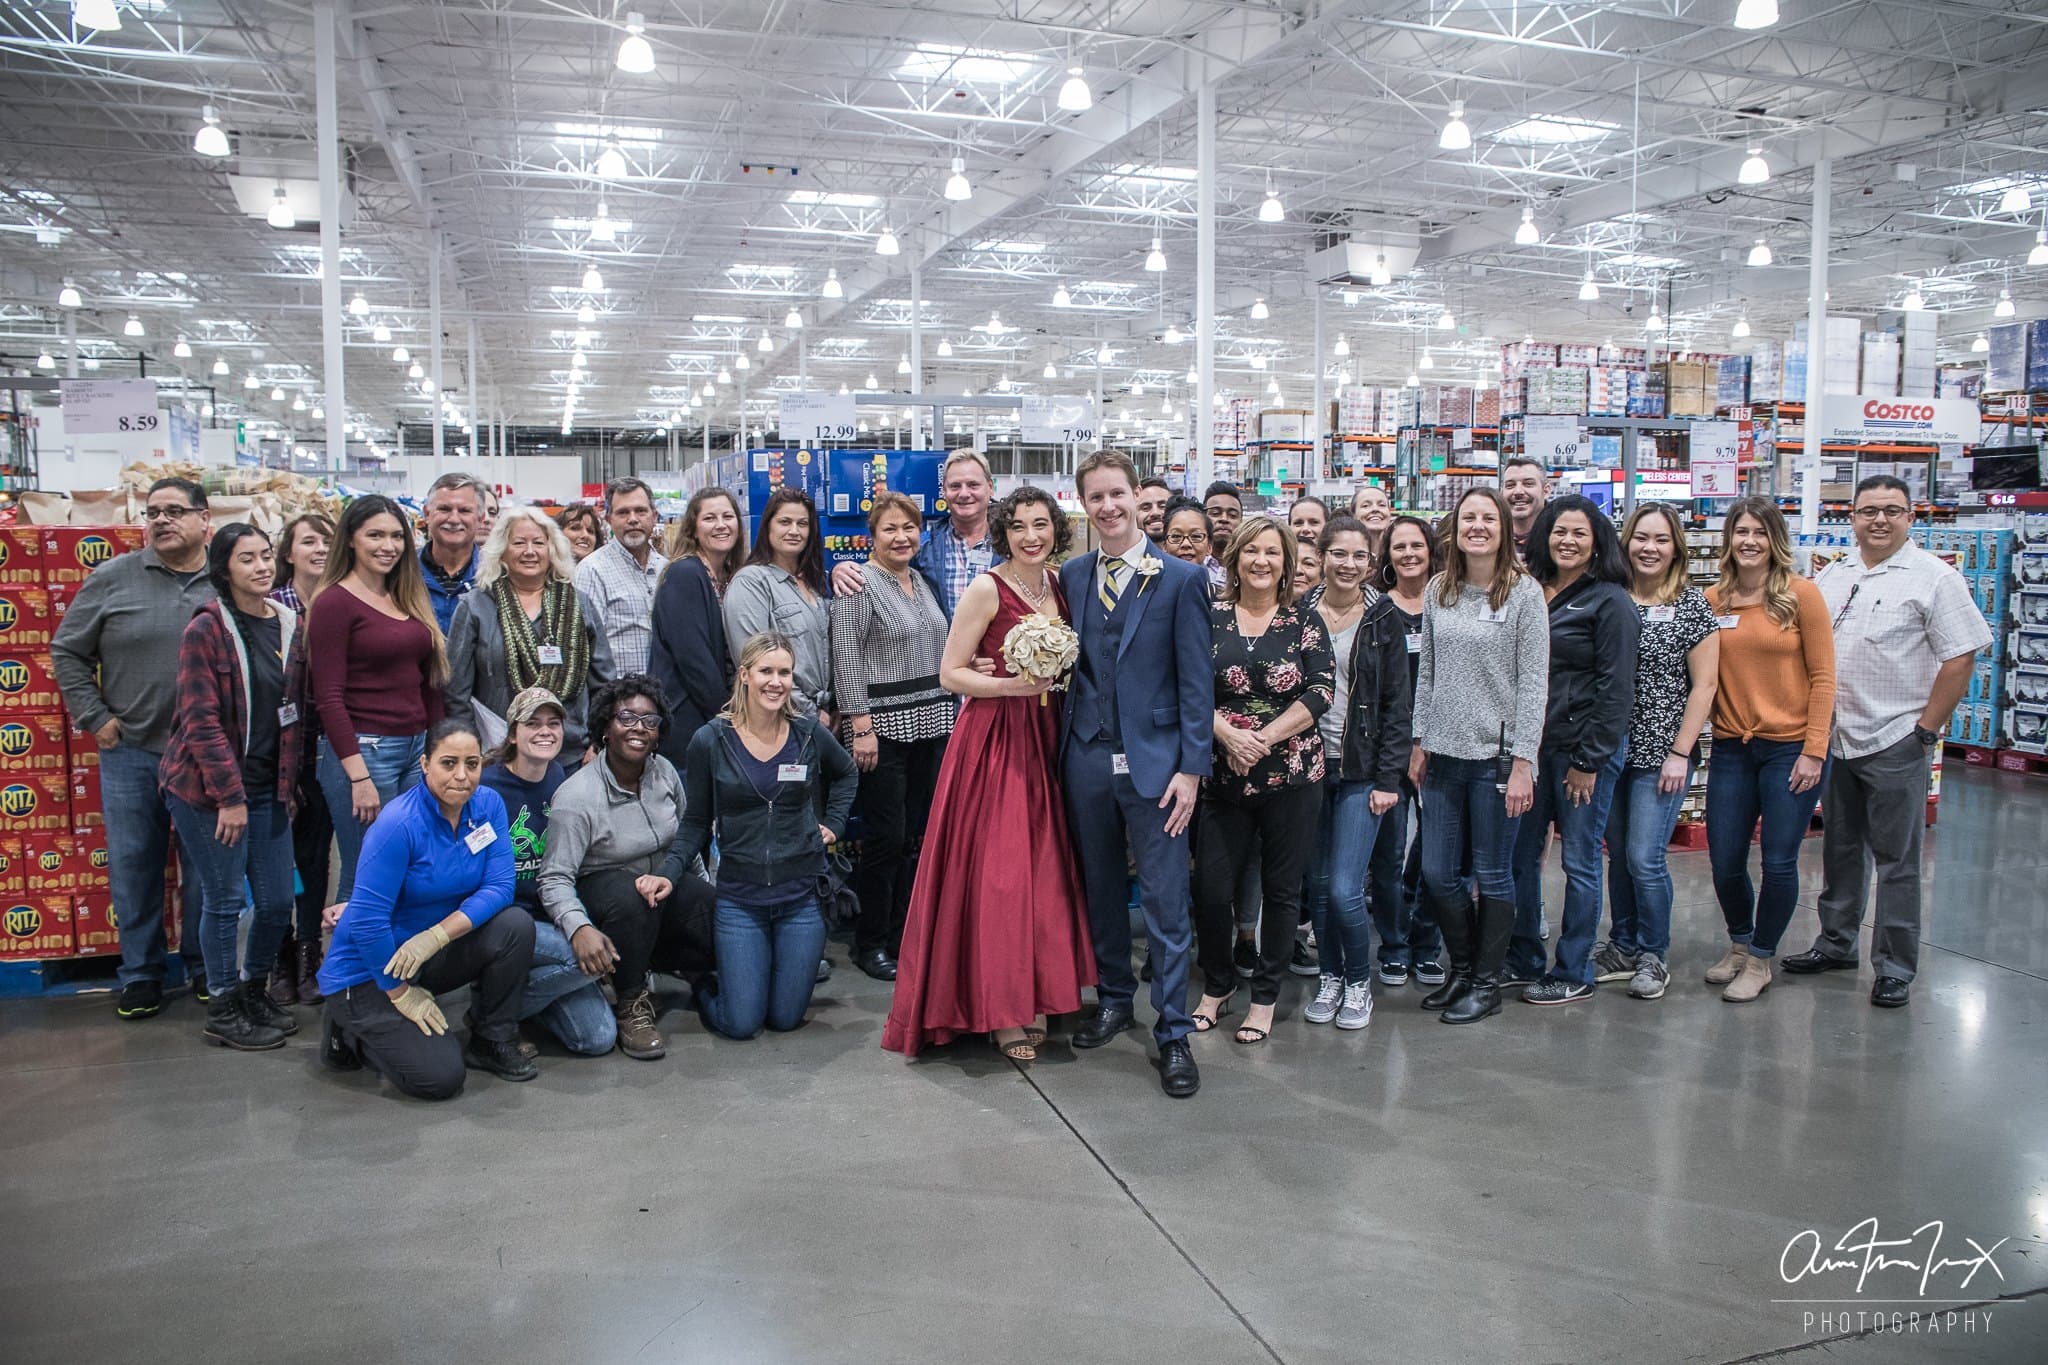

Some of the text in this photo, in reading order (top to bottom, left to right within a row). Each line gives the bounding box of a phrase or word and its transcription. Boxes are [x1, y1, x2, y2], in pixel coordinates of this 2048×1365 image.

[2008, 396, 2026, 409] 113
[1732, 408, 1748, 419] 115
[1864, 400, 1934, 420] COSTCO
[119, 416, 158, 431] 8.59
[816, 425, 854, 439] 12.99
[1063, 429, 1092, 442] 7.99
[1834, 428, 1864, 437] Expanded
[1866, 429, 1893, 437] Selection
[1895, 430, 1922, 438] Delivered
[1555, 443, 1577, 455] 6.69
[1716, 446, 1736, 458] 9.79
[863, 463, 871, 498] Classic Mix
[2002, 495, 2016, 504] LG
[46, 541, 58, 549] 18
[79, 541, 112, 564] RITZ
[833, 552, 854, 560] Classic
[54, 602, 66, 611] 18
[0, 728, 30, 752] RITZ
[75, 785, 86, 794] 18
[2, 786, 35, 813] RITZ
[41, 855, 60, 868] RITZ
[79, 906, 89, 914] 18
[5, 911, 40, 933] RITZ
